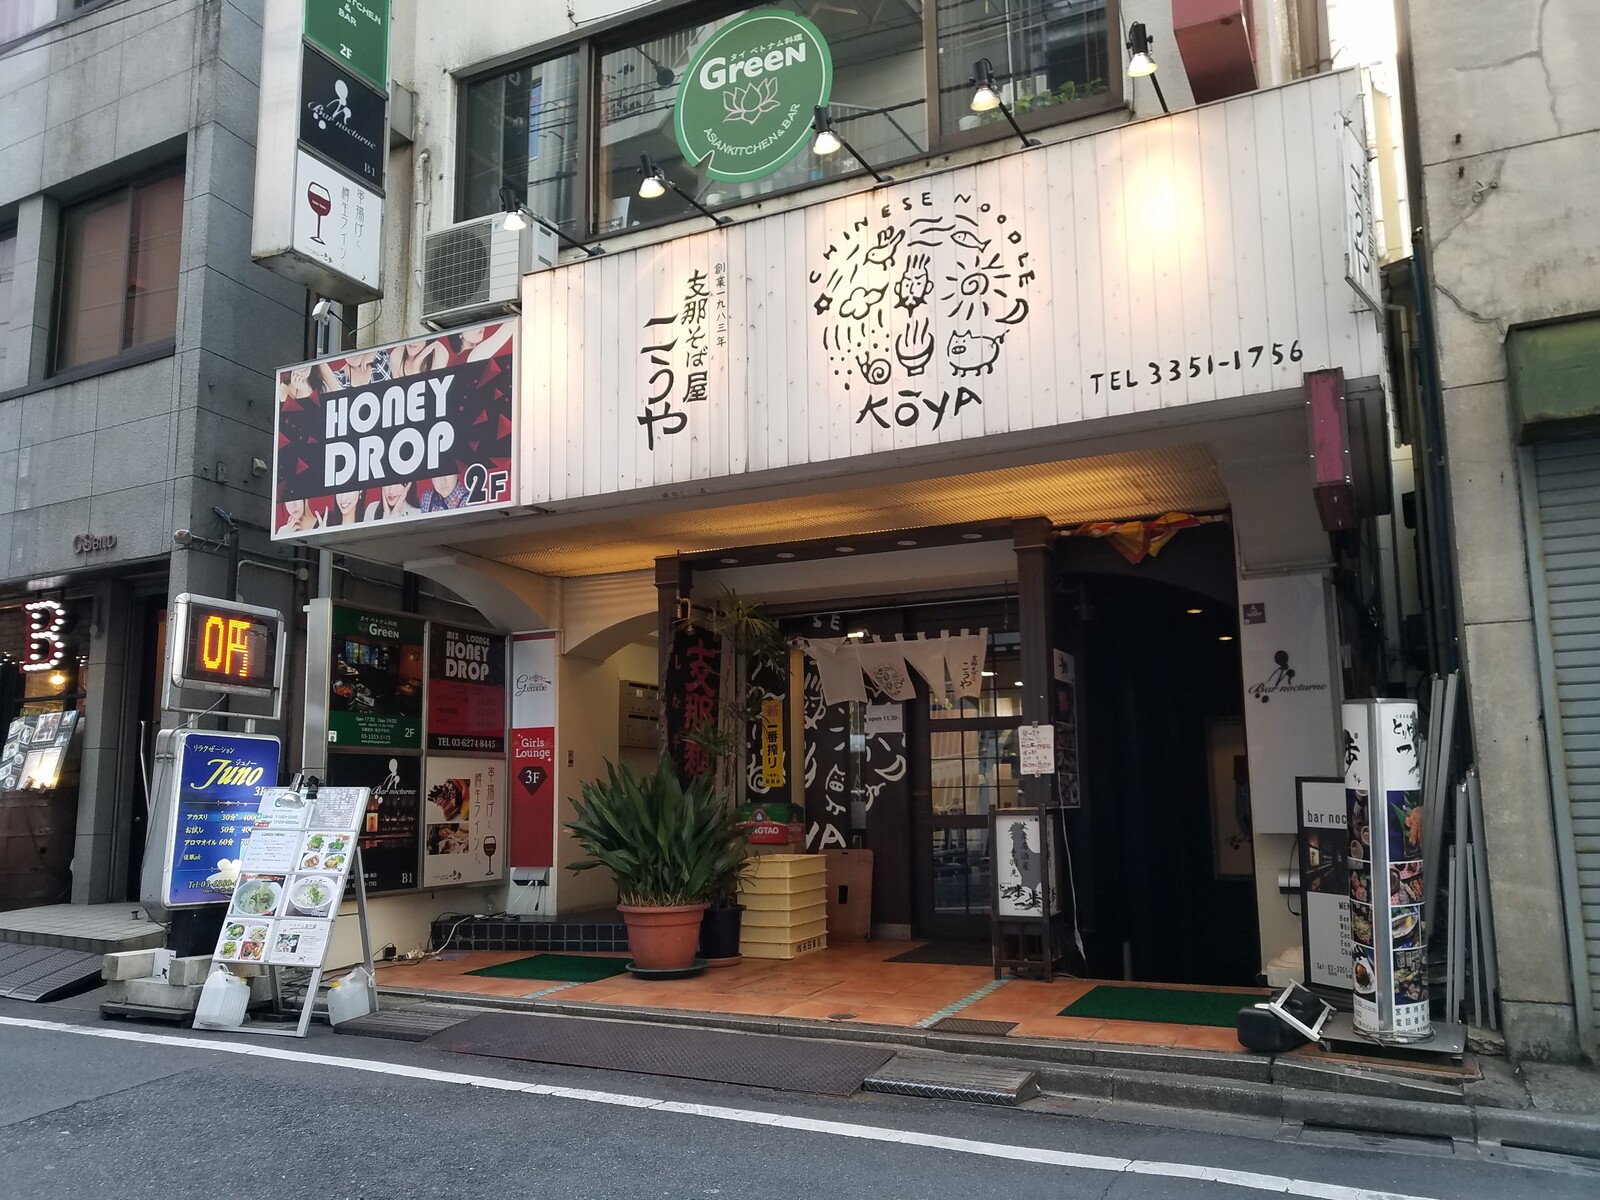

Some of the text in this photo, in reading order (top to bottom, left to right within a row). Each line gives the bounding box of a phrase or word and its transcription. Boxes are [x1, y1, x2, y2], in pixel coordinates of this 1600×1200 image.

[344, 3, 351, 13] &
[338, 8, 357, 26] BAR
[340, 43, 352, 59] 2F
[730, 33, 803, 62] タイ ベトナム料理
[781, 103, 801, 129] BAR
[308, 102, 376, 149] Bar nocturne
[364, 163, 375, 177] B1
[954, 193, 1035, 288] NOODLE
[713, 262, 727, 347] 創業一九八三年
[680, 269, 710, 403] 支那そば屋
[1090, 340, 1303, 394] TEL 3351-1756
[325, 374, 455, 439] HONEY
[324, 420, 455, 487] DROP
[464, 463, 508, 506] 2F
[446, 631, 490, 646] MIX LOUNGE
[446, 640, 490, 662] HONEY
[445, 658, 490, 681] DROP
[1248, 682, 1327, 694] Bar nocturne
[404, 727, 415, 738] 2F
[438, 737, 451, 747] TEL
[521, 737, 545, 748] Girls
[767, 724, 778, 769] 一番搾り
[235, 758, 258, 766] ジュノー
[515, 749, 550, 760] Lounge
[190, 758, 264, 790] Juno
[525, 769, 540, 785] 3F
[371, 785, 416, 796] Bar nocturne
[1307, 810, 1324, 823] bar
[402, 872, 413, 884] B1
[1340, 923, 1349, 931] Whi
